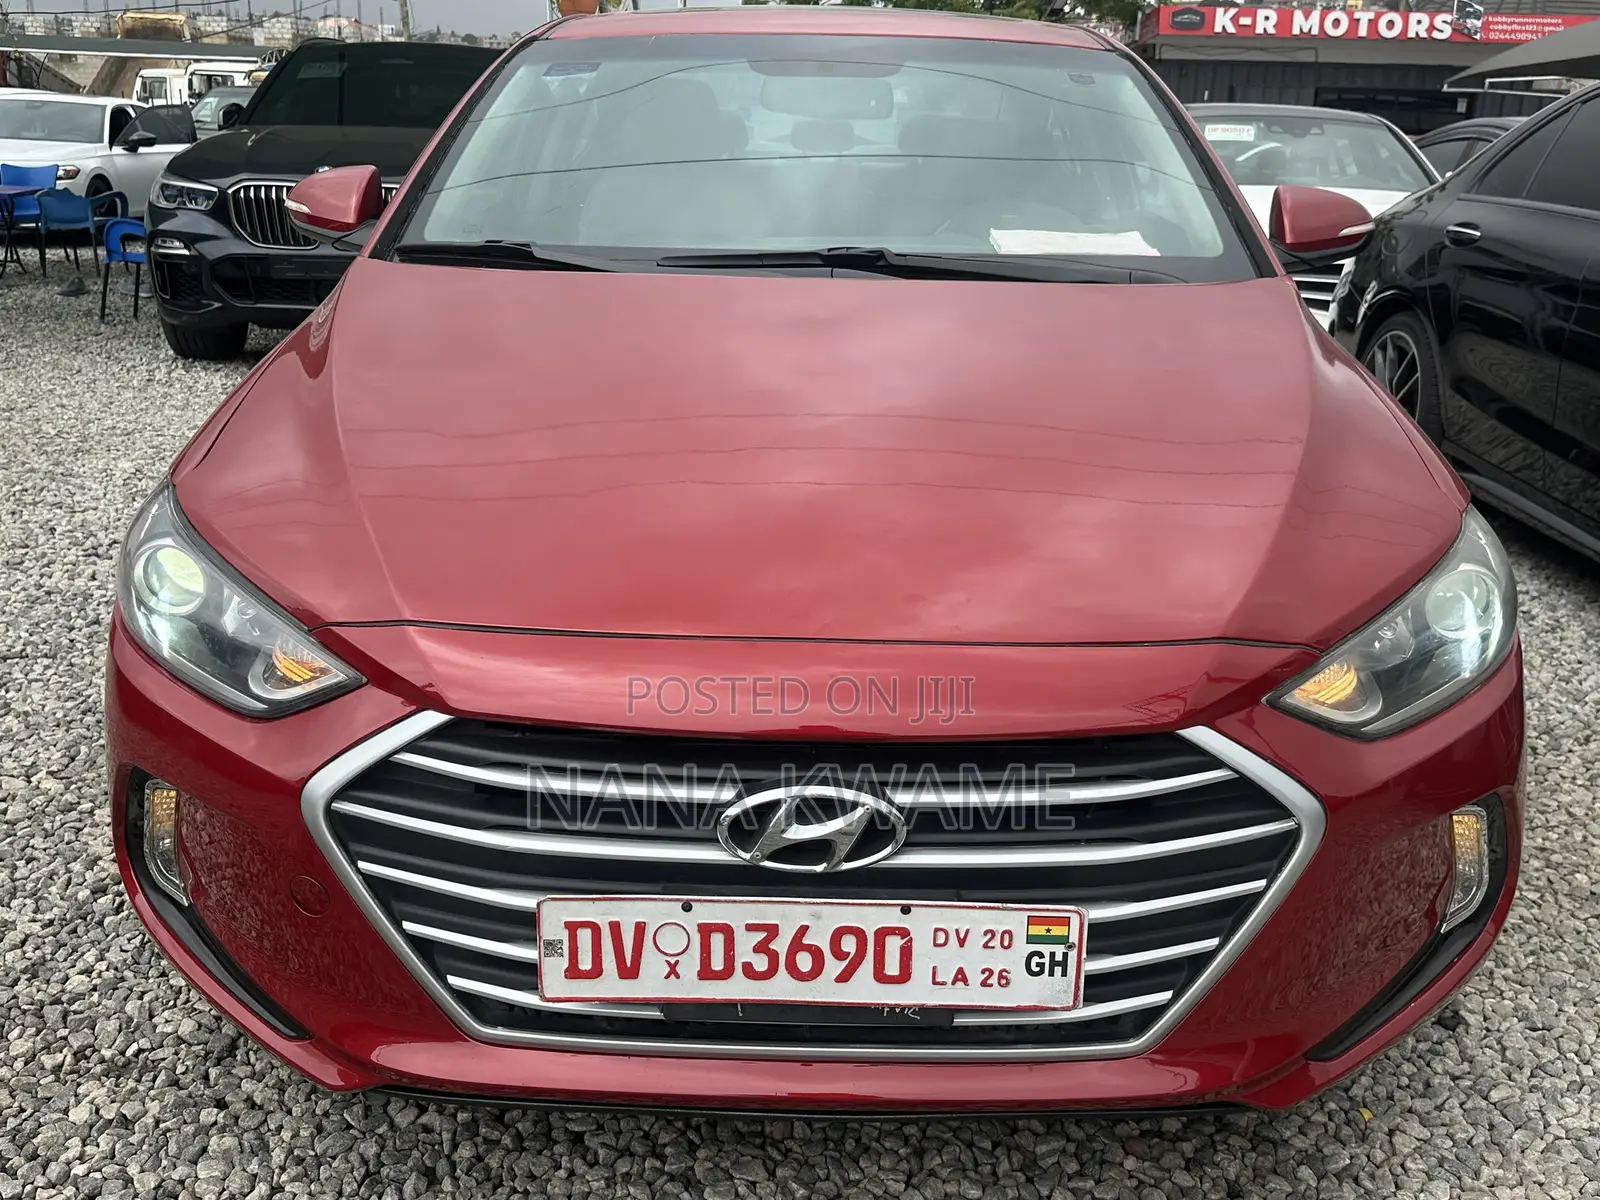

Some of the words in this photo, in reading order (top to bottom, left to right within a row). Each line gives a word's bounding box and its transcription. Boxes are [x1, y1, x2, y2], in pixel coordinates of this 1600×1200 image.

[1213, 8, 1277, 35] K-R
[1291, 10, 1453, 40] MOTORS
[564, 920, 647, 980] DV
[696, 922, 914, 985] D3690
[932, 927, 971, 948] DV
[982, 928, 1014, 950] 20
[931, 965, 970, 987] LA
[979, 967, 1012, 988] 26
[1024, 950, 1069, 978] GH
